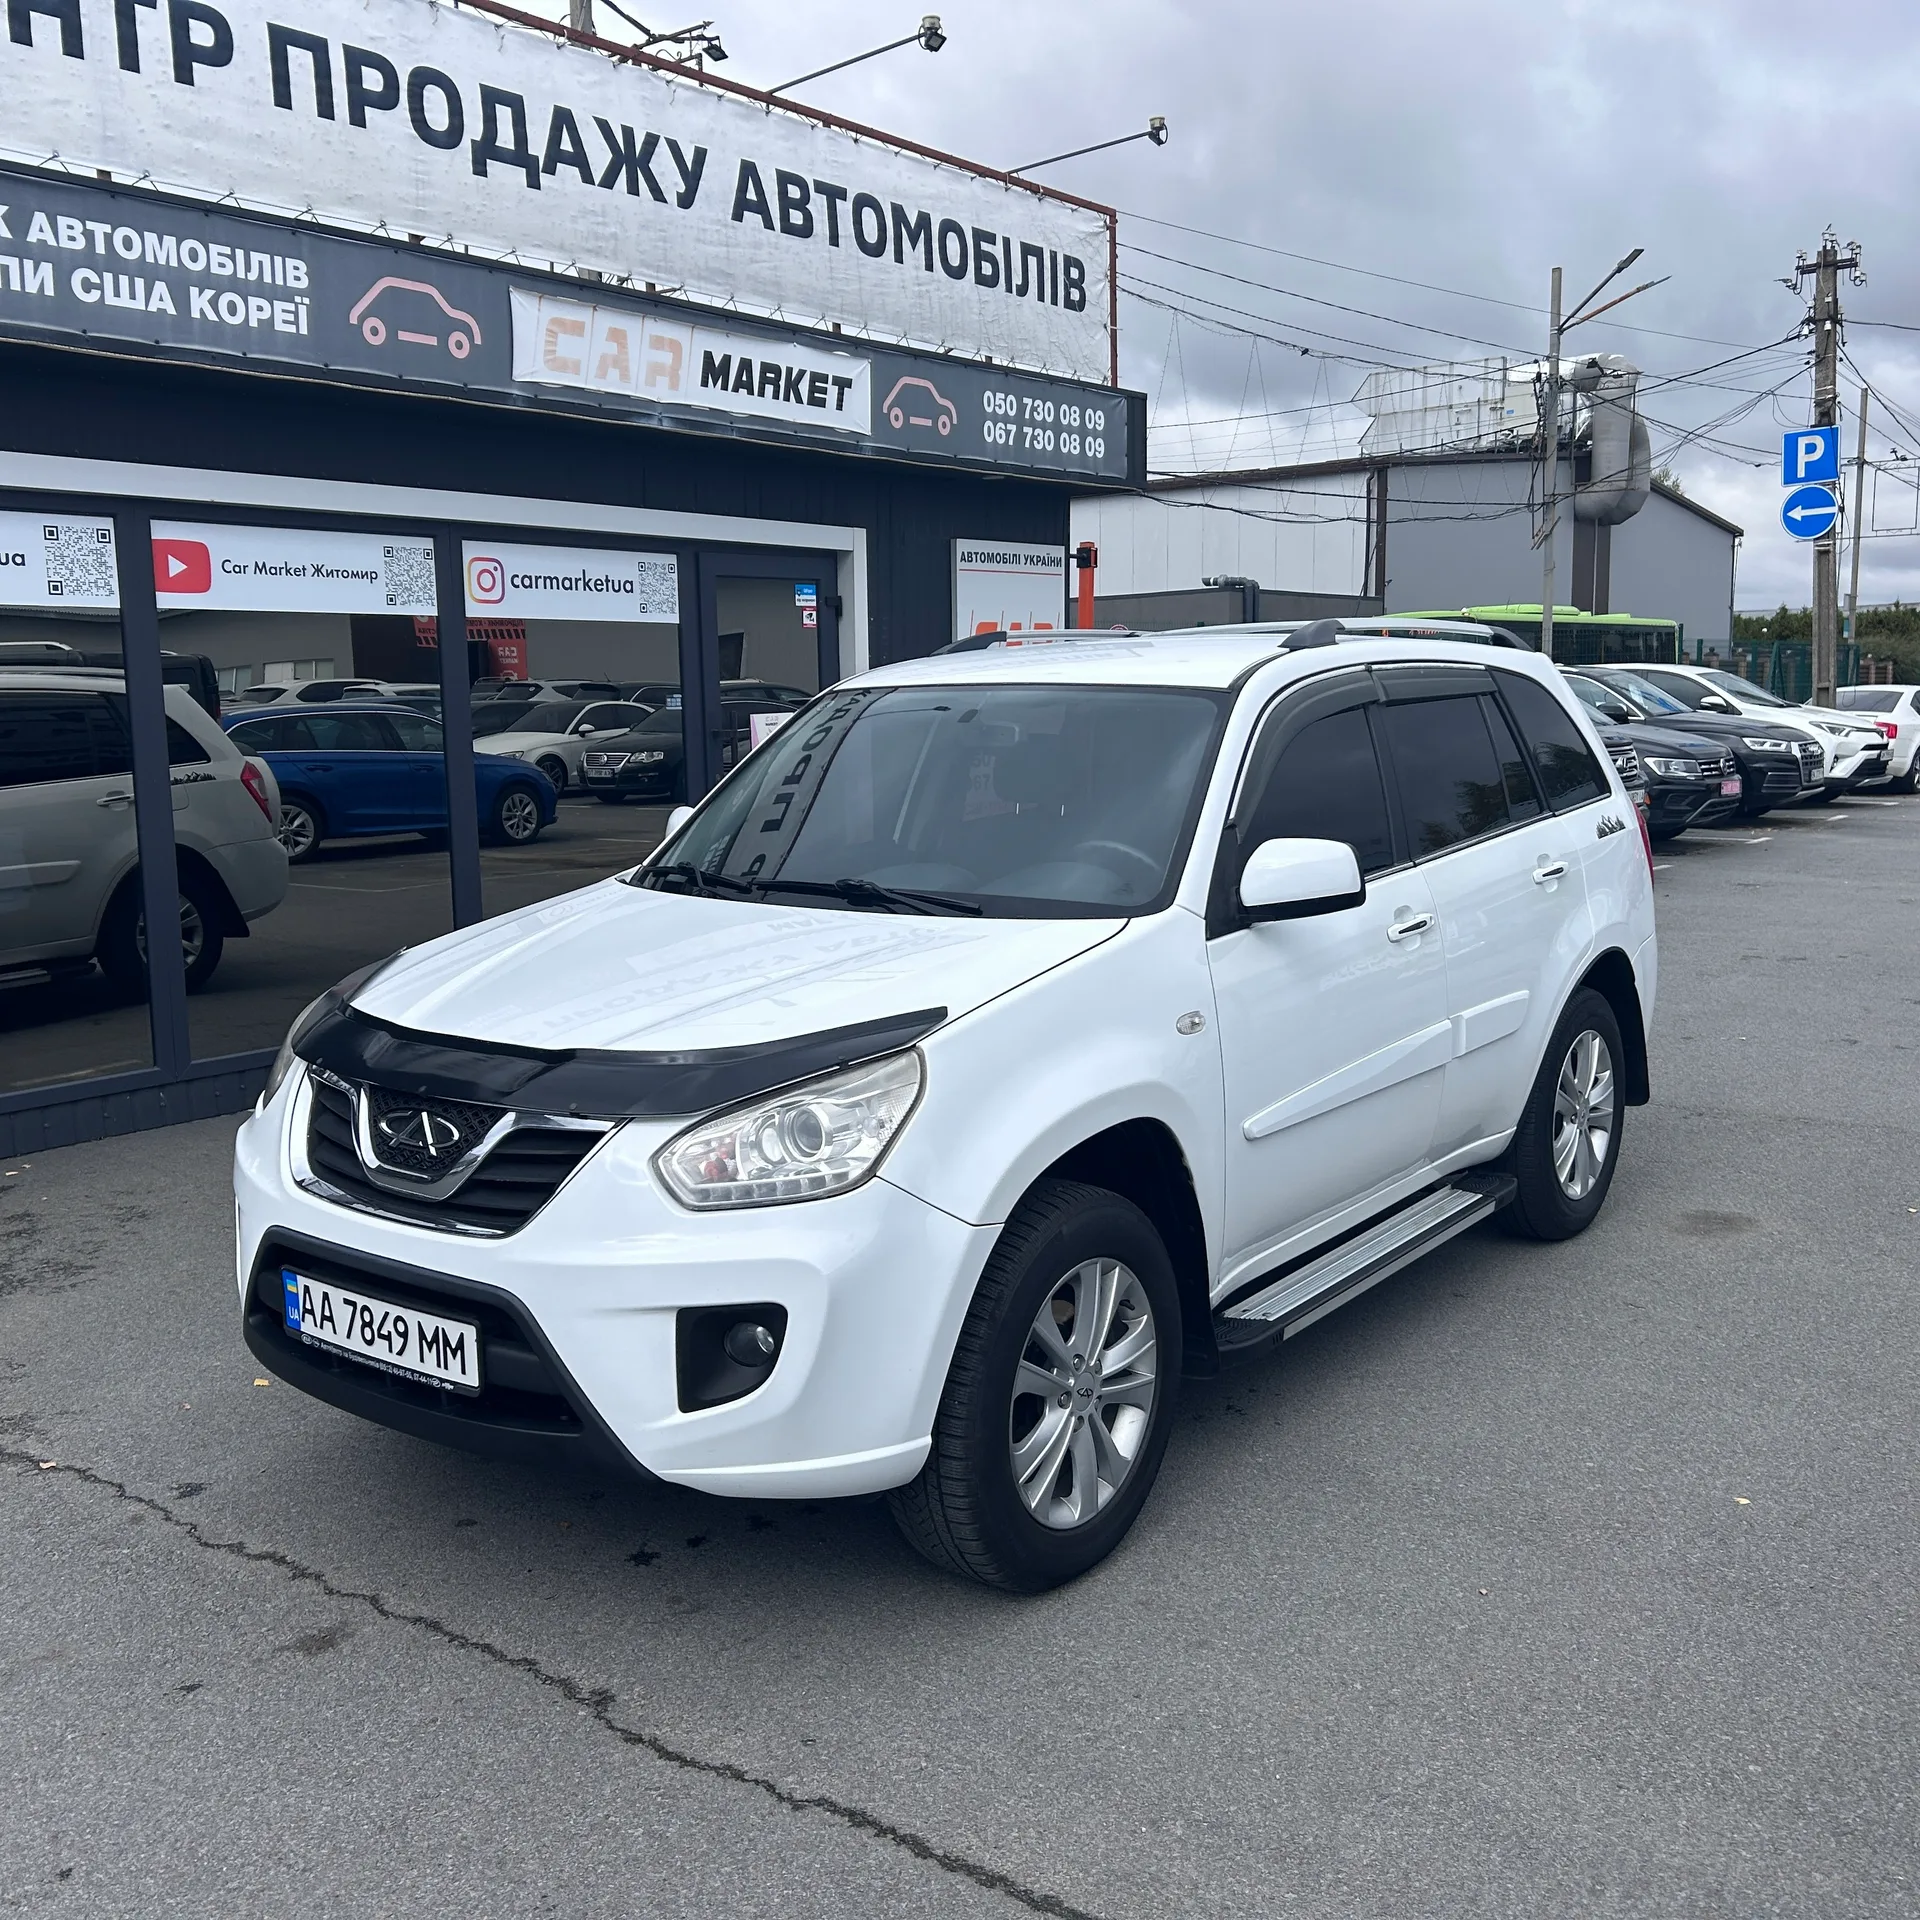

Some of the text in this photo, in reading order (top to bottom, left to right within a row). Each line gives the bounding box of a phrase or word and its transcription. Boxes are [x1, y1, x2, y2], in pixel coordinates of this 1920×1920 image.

[266, 22, 707, 209] ПРОДАЖУ
[731, 158, 1087, 312] АВТОМОБІЛІВ
[26, 211, 309, 289] АВТОМОБІЛІВ
[72, 267, 177, 316] США
[190, 286, 310, 336] КОРЕЇ
[542, 316, 853, 411] CAR MARKET
[983, 390, 1105, 431] 050 730 08 09
[983, 420, 1105, 458] 067 730 08 09
[1797, 434, 1824, 478] P
[221, 559, 378, 584] Car Market Житомир
[960, 551, 1062, 568] АВТОМОБІЛІ УКРАЇНИ
[509, 569, 634, 597] carmarketua
[288, 1306, 299, 1322] UA
[301, 1284, 337, 1335] AA
[343, 1298, 409, 1356] 7849
[417, 1320, 467, 1375] MM
